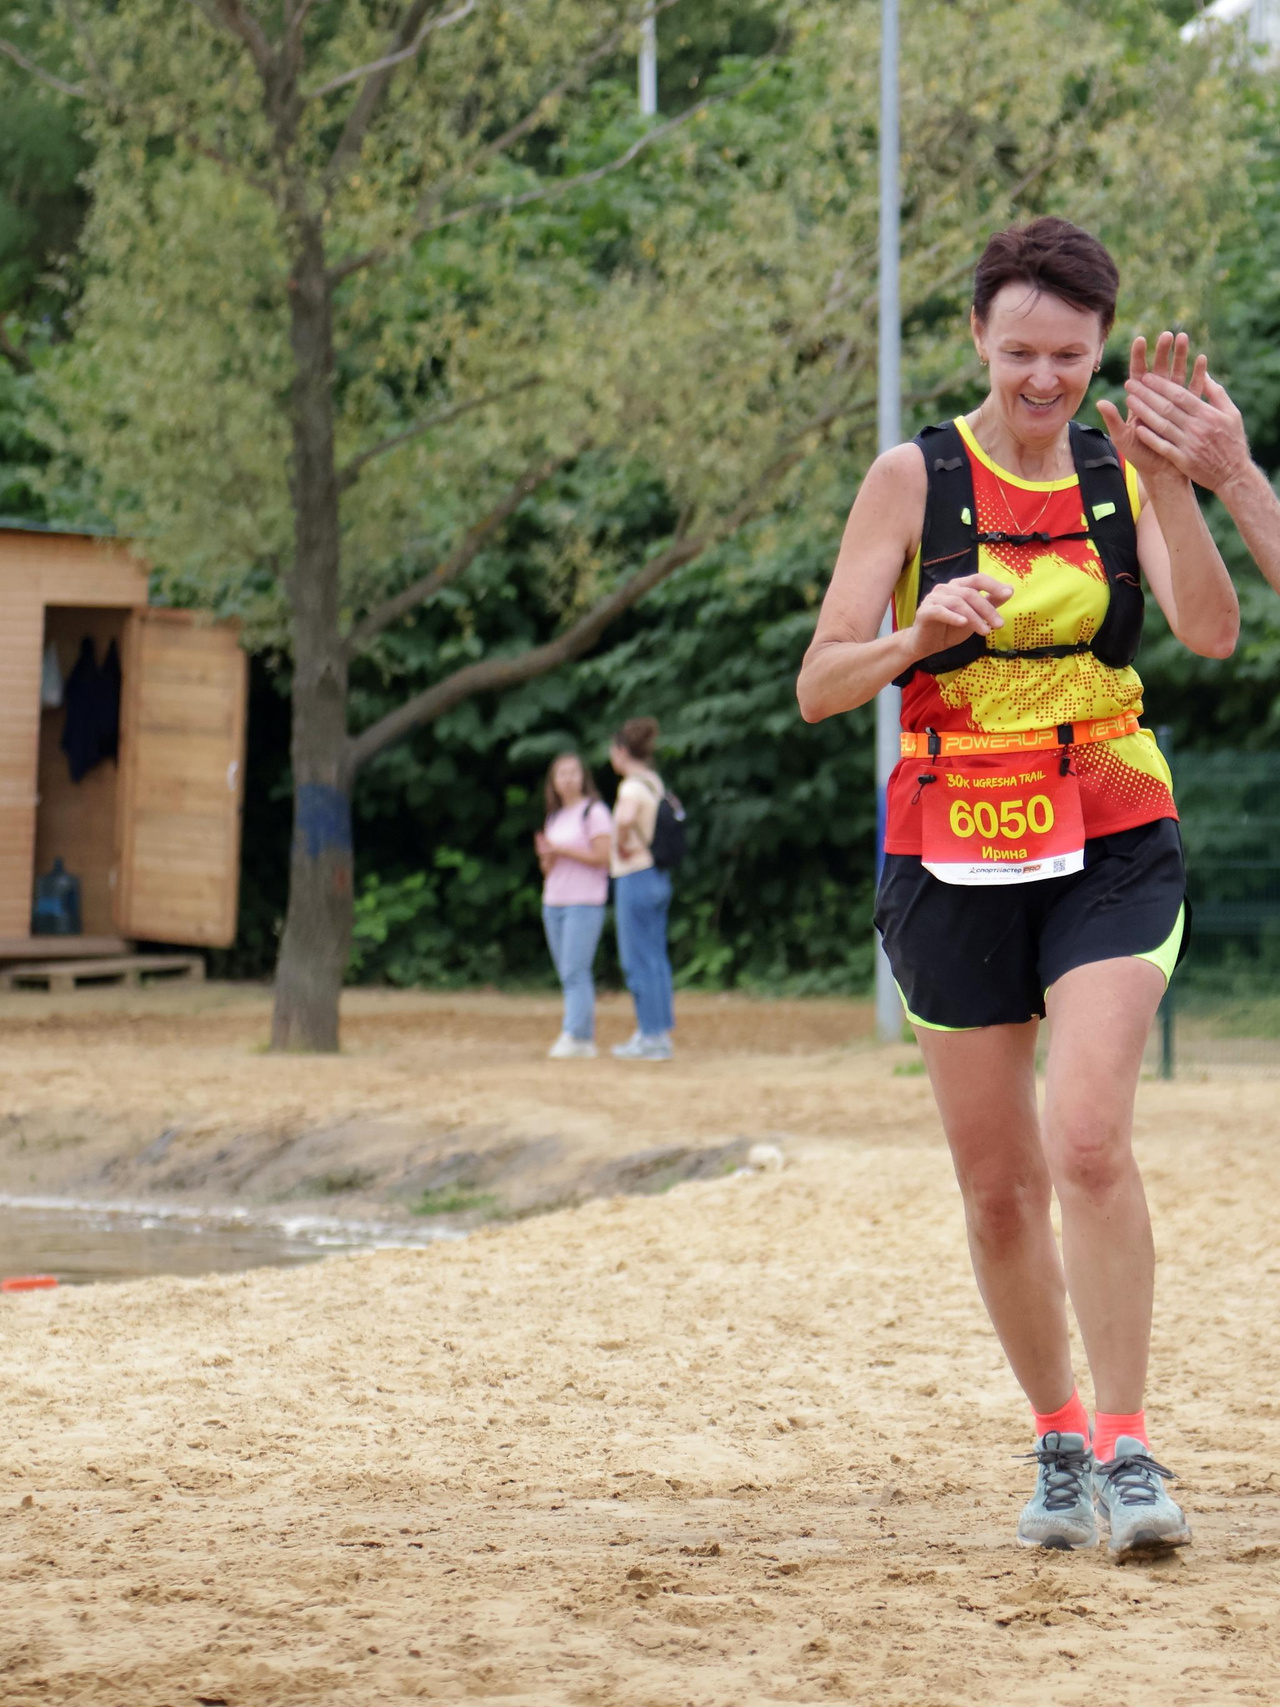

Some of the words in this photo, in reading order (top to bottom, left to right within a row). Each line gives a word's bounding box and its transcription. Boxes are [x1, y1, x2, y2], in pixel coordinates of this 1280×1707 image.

[945, 731, 1054, 750] POWERUP
[973, 776, 1018, 788] UGRESHA
[1018, 770, 1046, 784] TRAIL
[950, 794, 1055, 839] 6050
[981, 846, 1028, 862] Ирина
[1022, 864, 1042, 873] PRO
